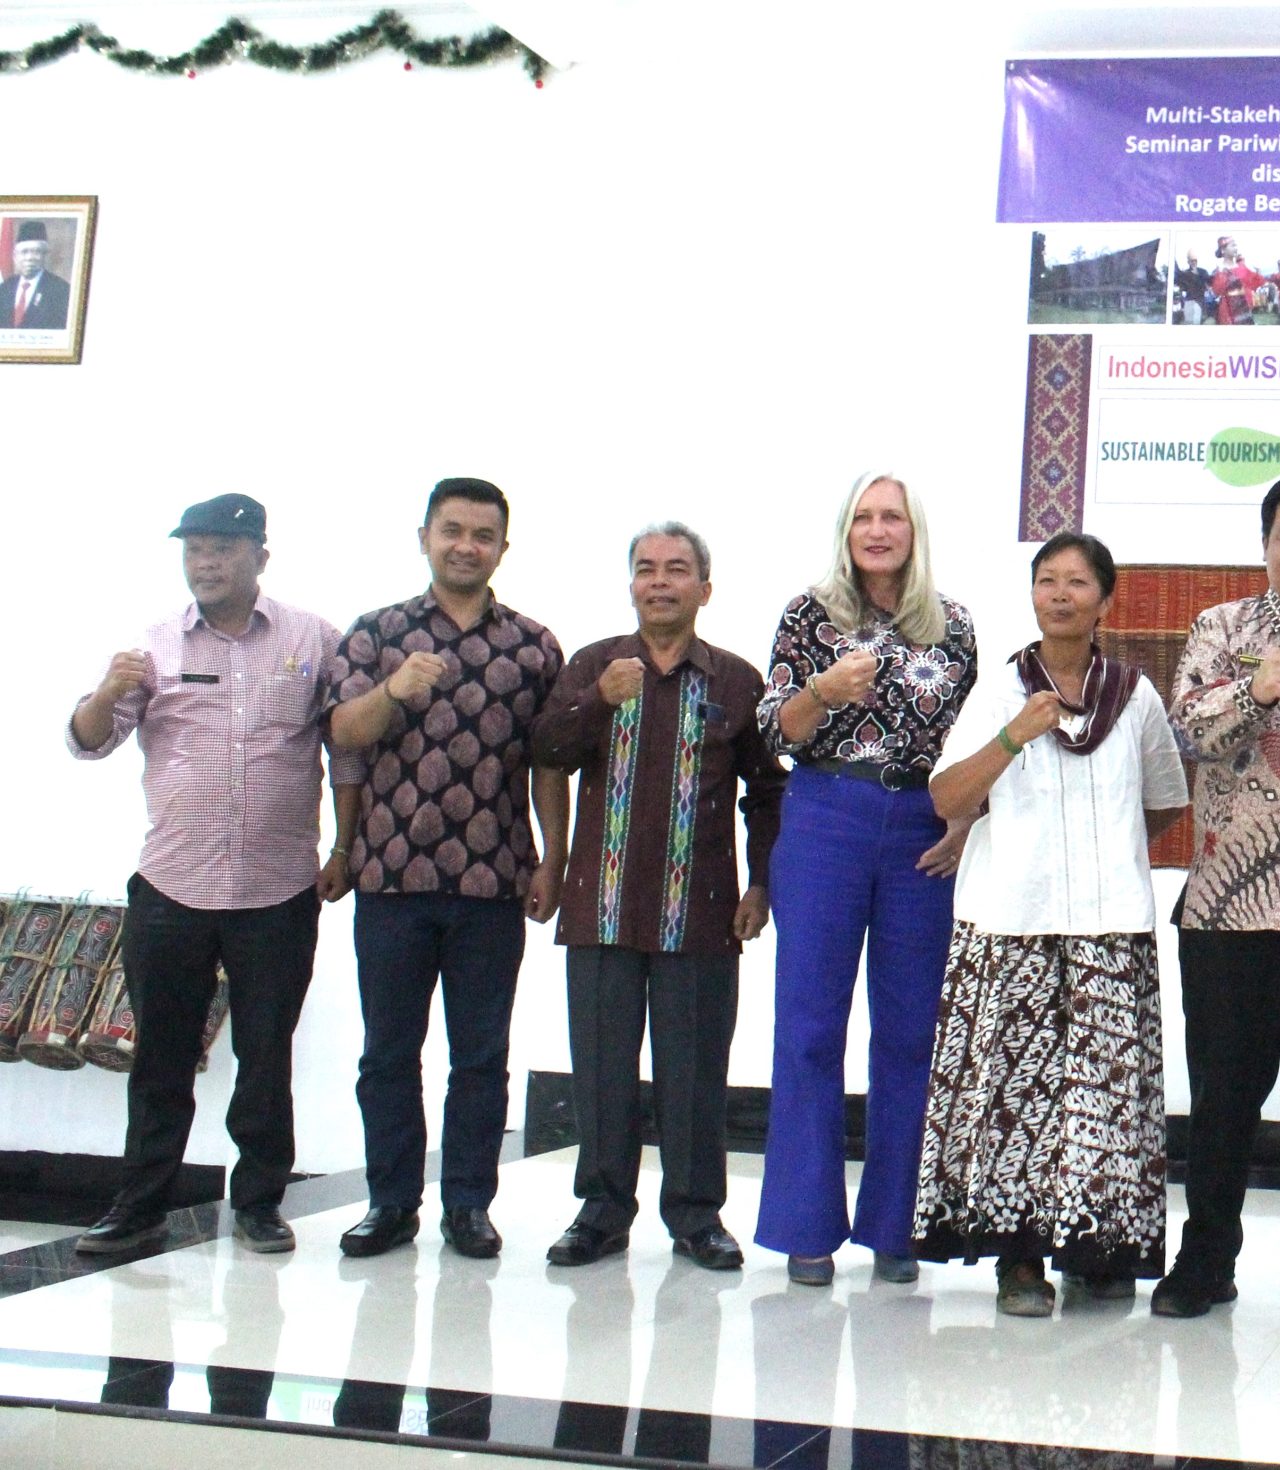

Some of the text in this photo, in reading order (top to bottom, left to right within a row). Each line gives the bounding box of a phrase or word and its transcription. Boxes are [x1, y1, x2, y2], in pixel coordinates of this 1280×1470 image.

[1125, 135, 1213, 153] Seminar
[1175, 194, 1248, 217] Rogate
[1101, 441, 1280, 463] SUSTAINABLE TOURISM
